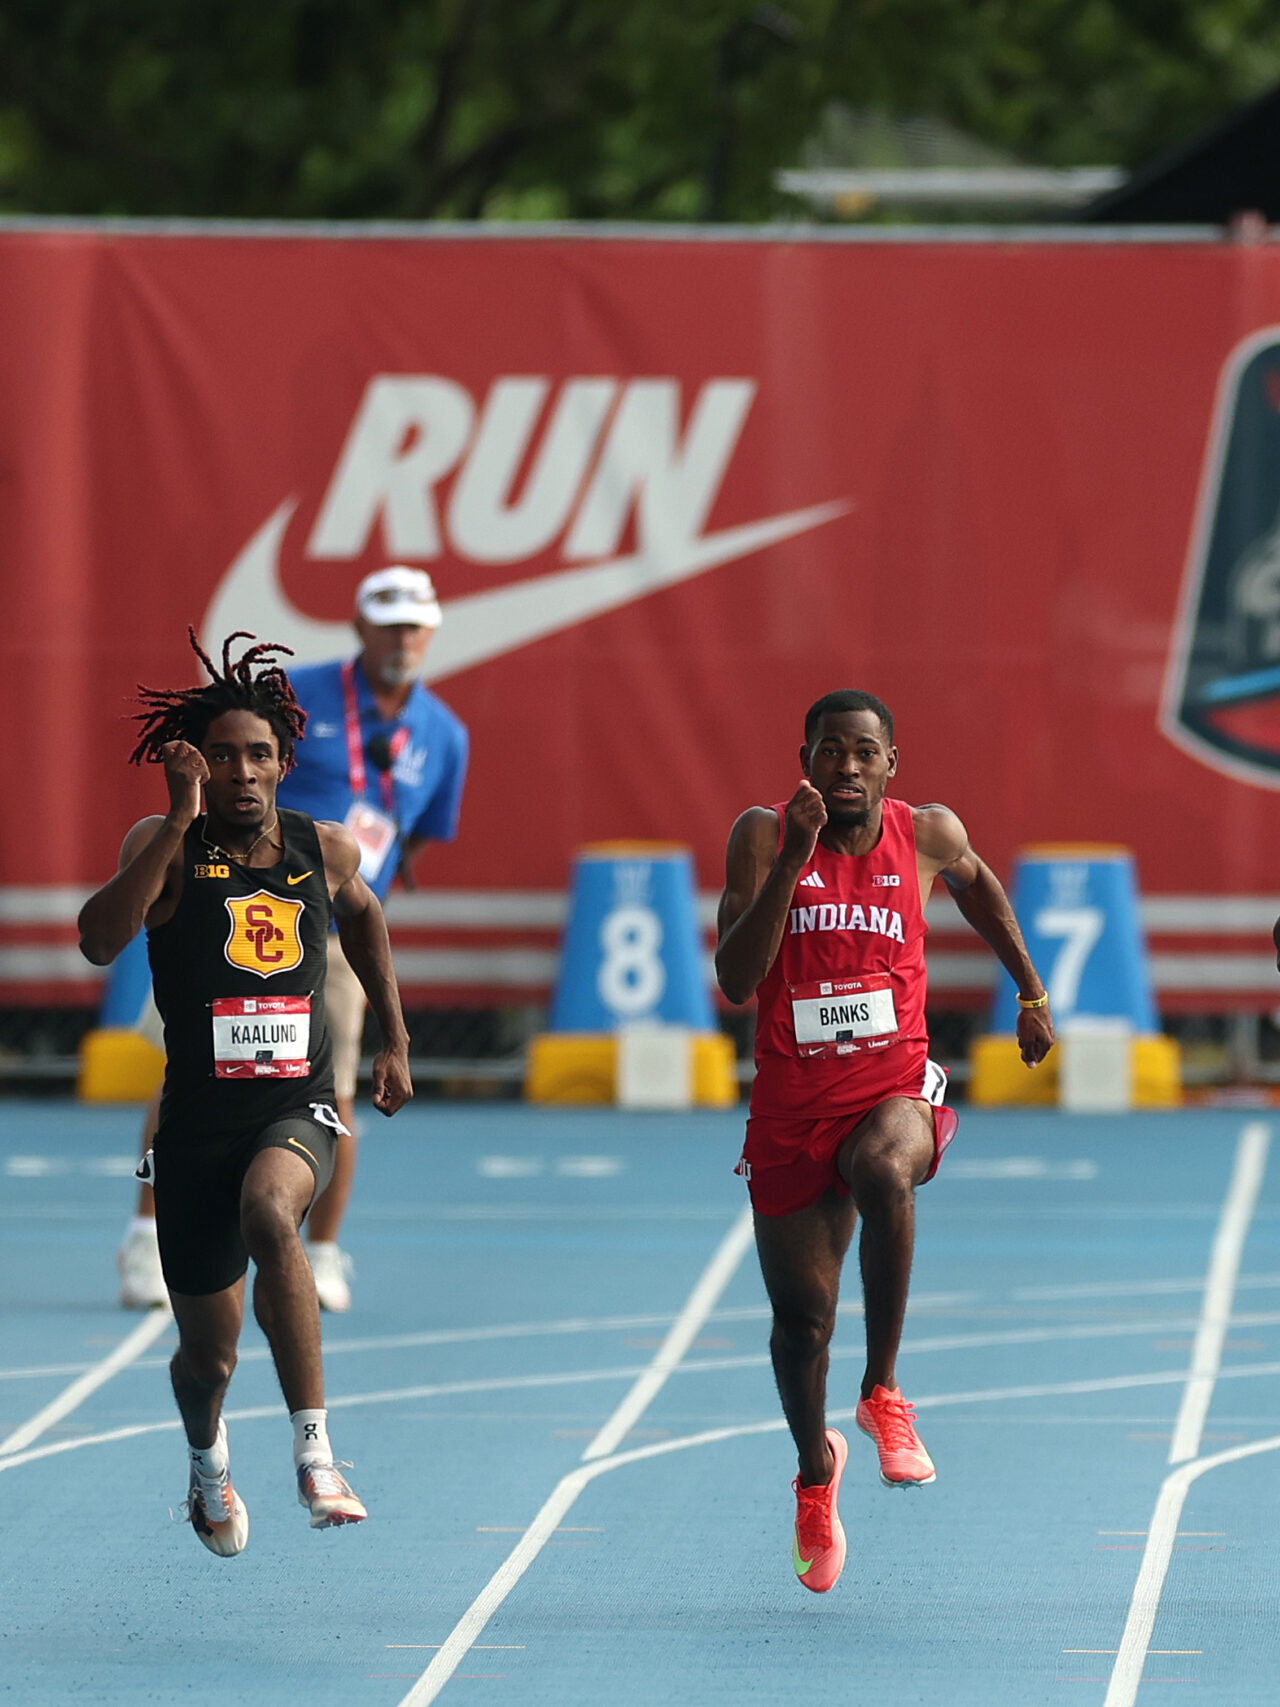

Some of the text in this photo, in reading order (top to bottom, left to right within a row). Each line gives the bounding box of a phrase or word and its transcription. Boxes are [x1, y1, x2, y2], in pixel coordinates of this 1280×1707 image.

[304, 373, 756, 565] RUN
[790, 903, 906, 944] INDIANA
[600, 905, 664, 1016] 8
[1035, 907, 1103, 1016] 7
[833, 982, 862, 991] TOYOTA
[258, 1002, 286, 1010] TOYOTA
[820, 1003, 870, 1026] BANKS
[231, 1024, 297, 1045] KAALUND
